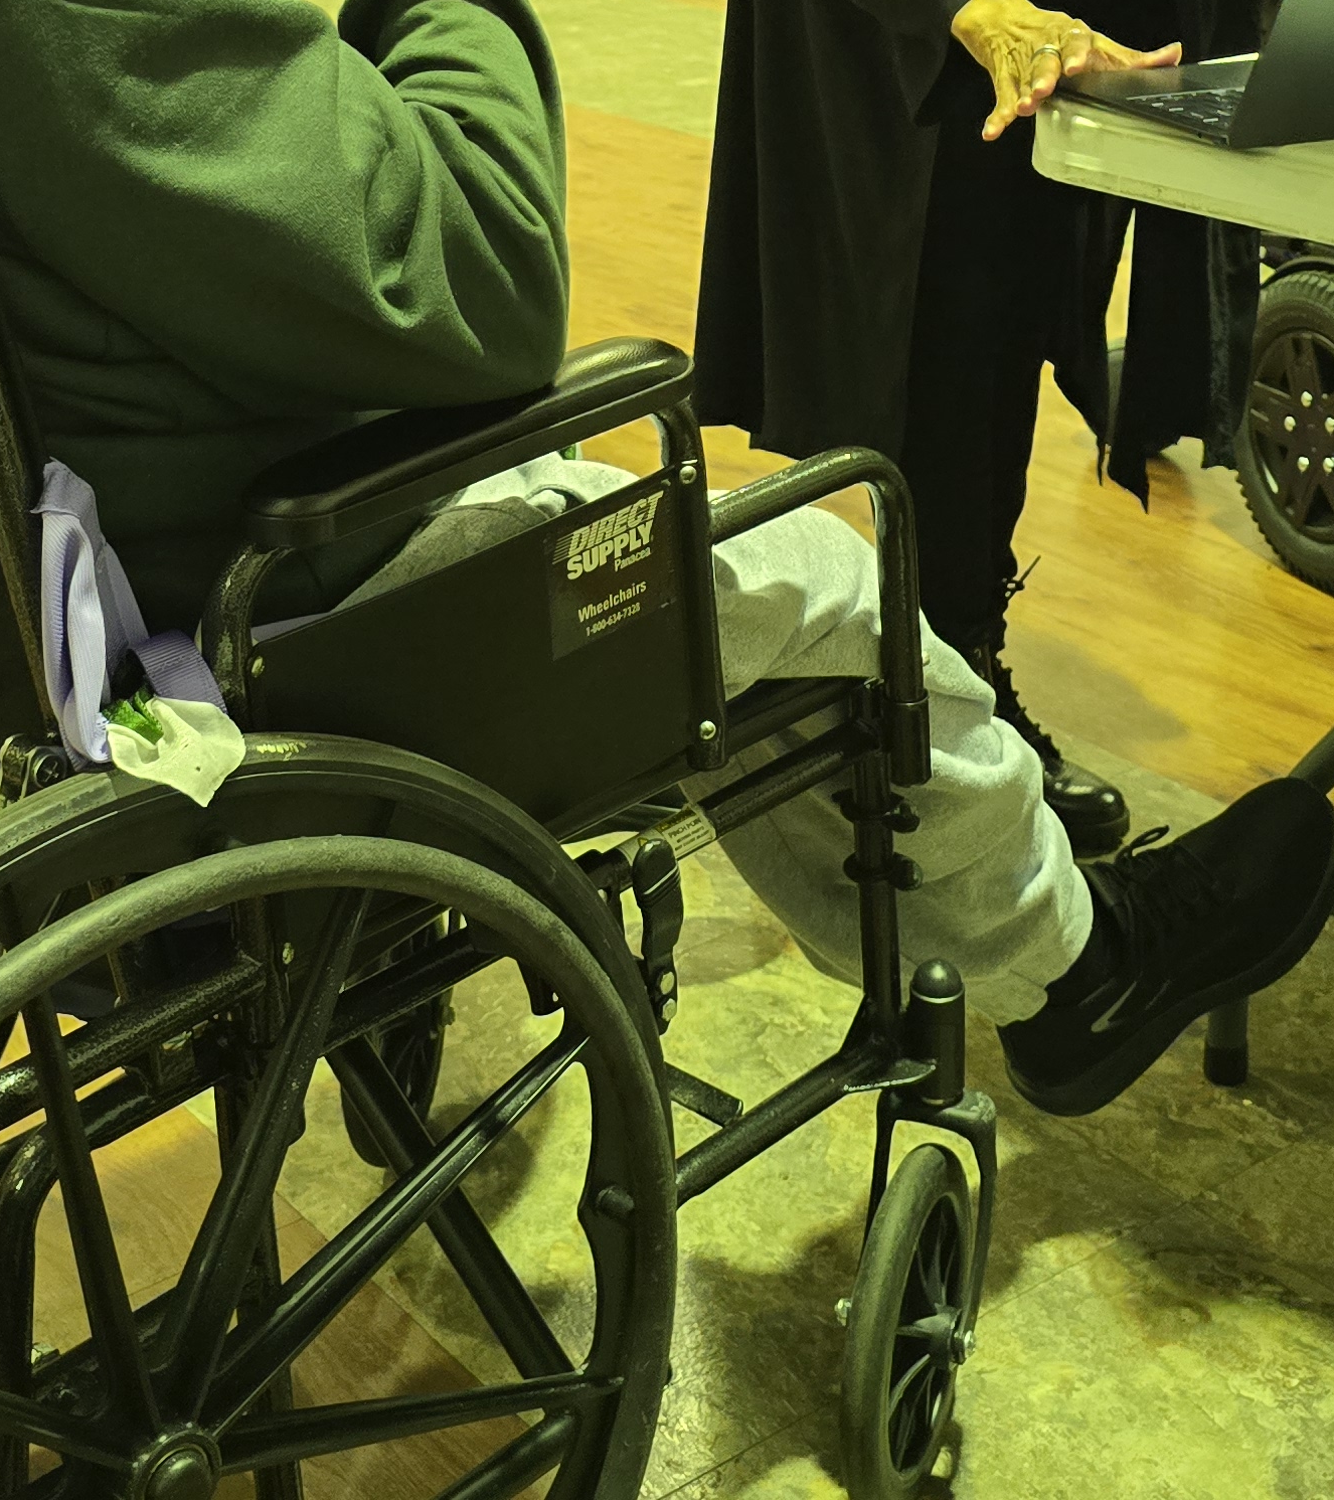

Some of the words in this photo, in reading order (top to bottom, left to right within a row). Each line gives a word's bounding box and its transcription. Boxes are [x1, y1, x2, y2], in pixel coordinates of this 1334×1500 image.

[566, 519, 654, 581] SUPPLY
[567, 490, 665, 558] DIRECT
[614, 547, 651, 573] Panacea
[578, 580, 647, 623] Wheelchairs
